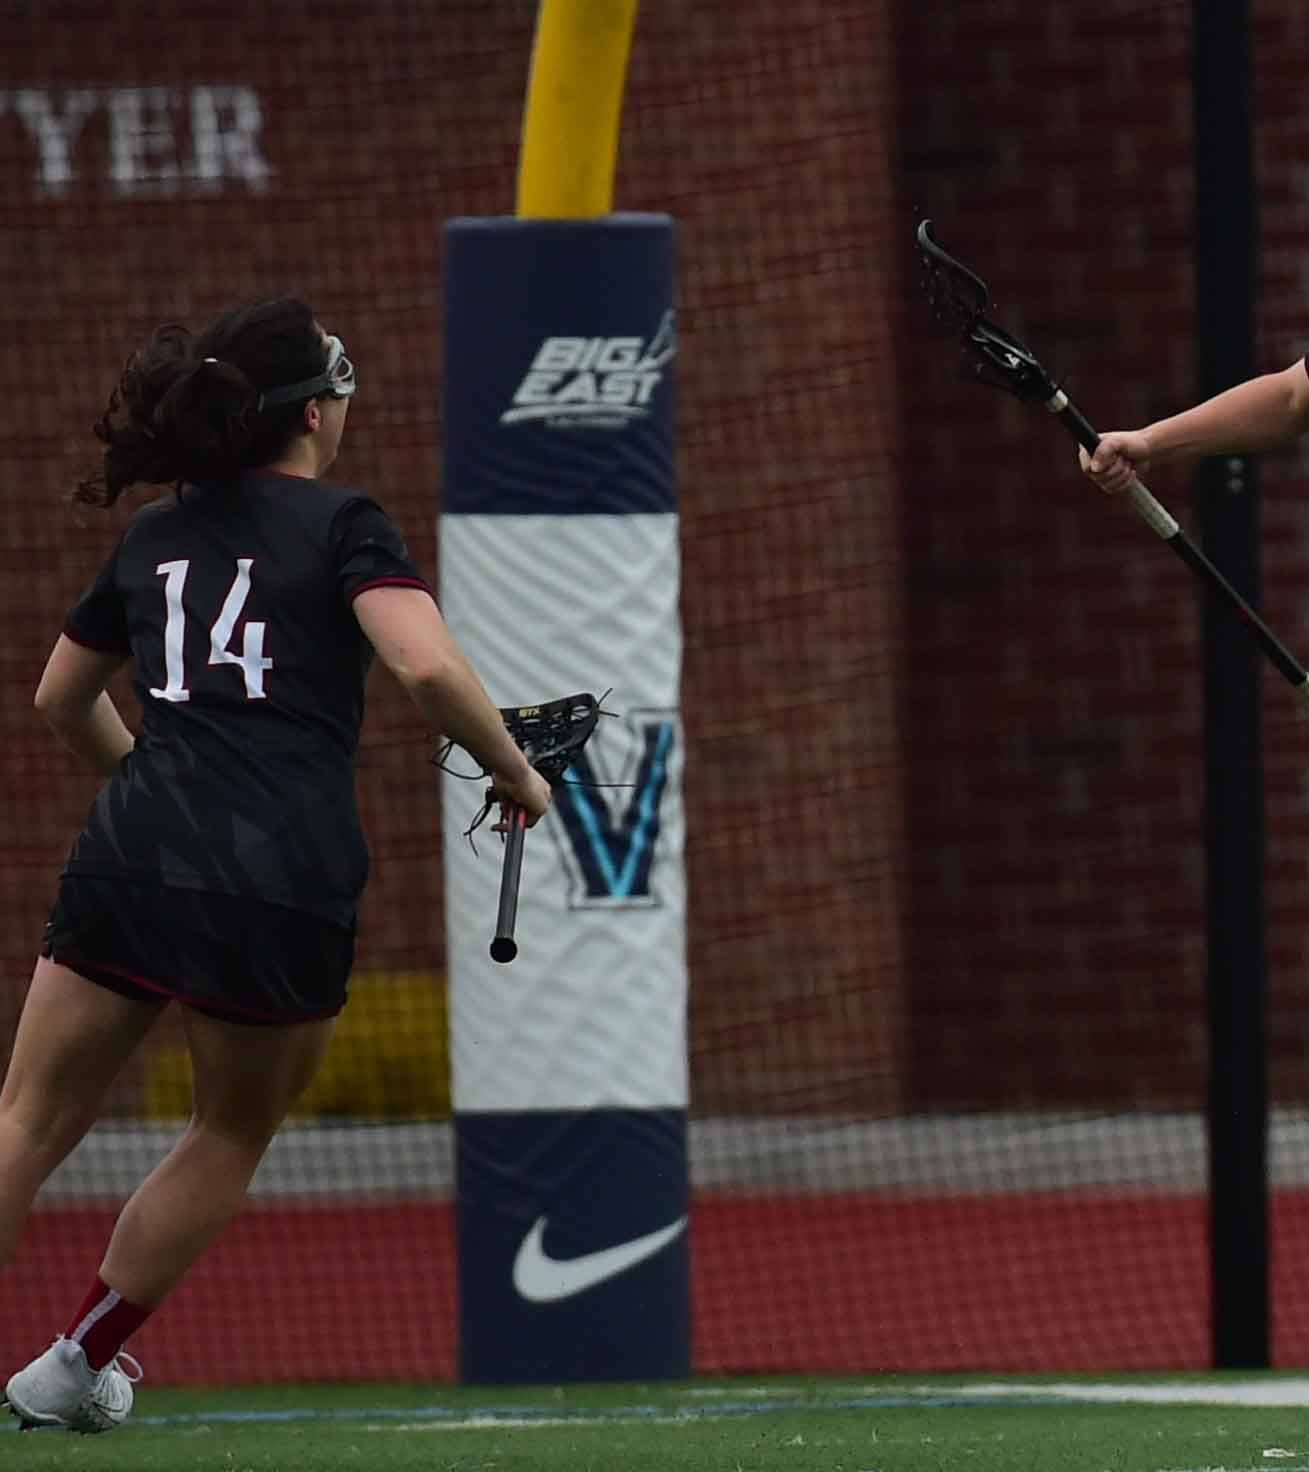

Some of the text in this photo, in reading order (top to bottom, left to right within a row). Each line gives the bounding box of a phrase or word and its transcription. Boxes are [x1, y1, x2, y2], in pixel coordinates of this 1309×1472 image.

[0, 87, 277, 196] YER
[512, 371, 661, 404] EAST
[532, 336, 643, 370] BIG
[149, 558, 273, 702] 14
